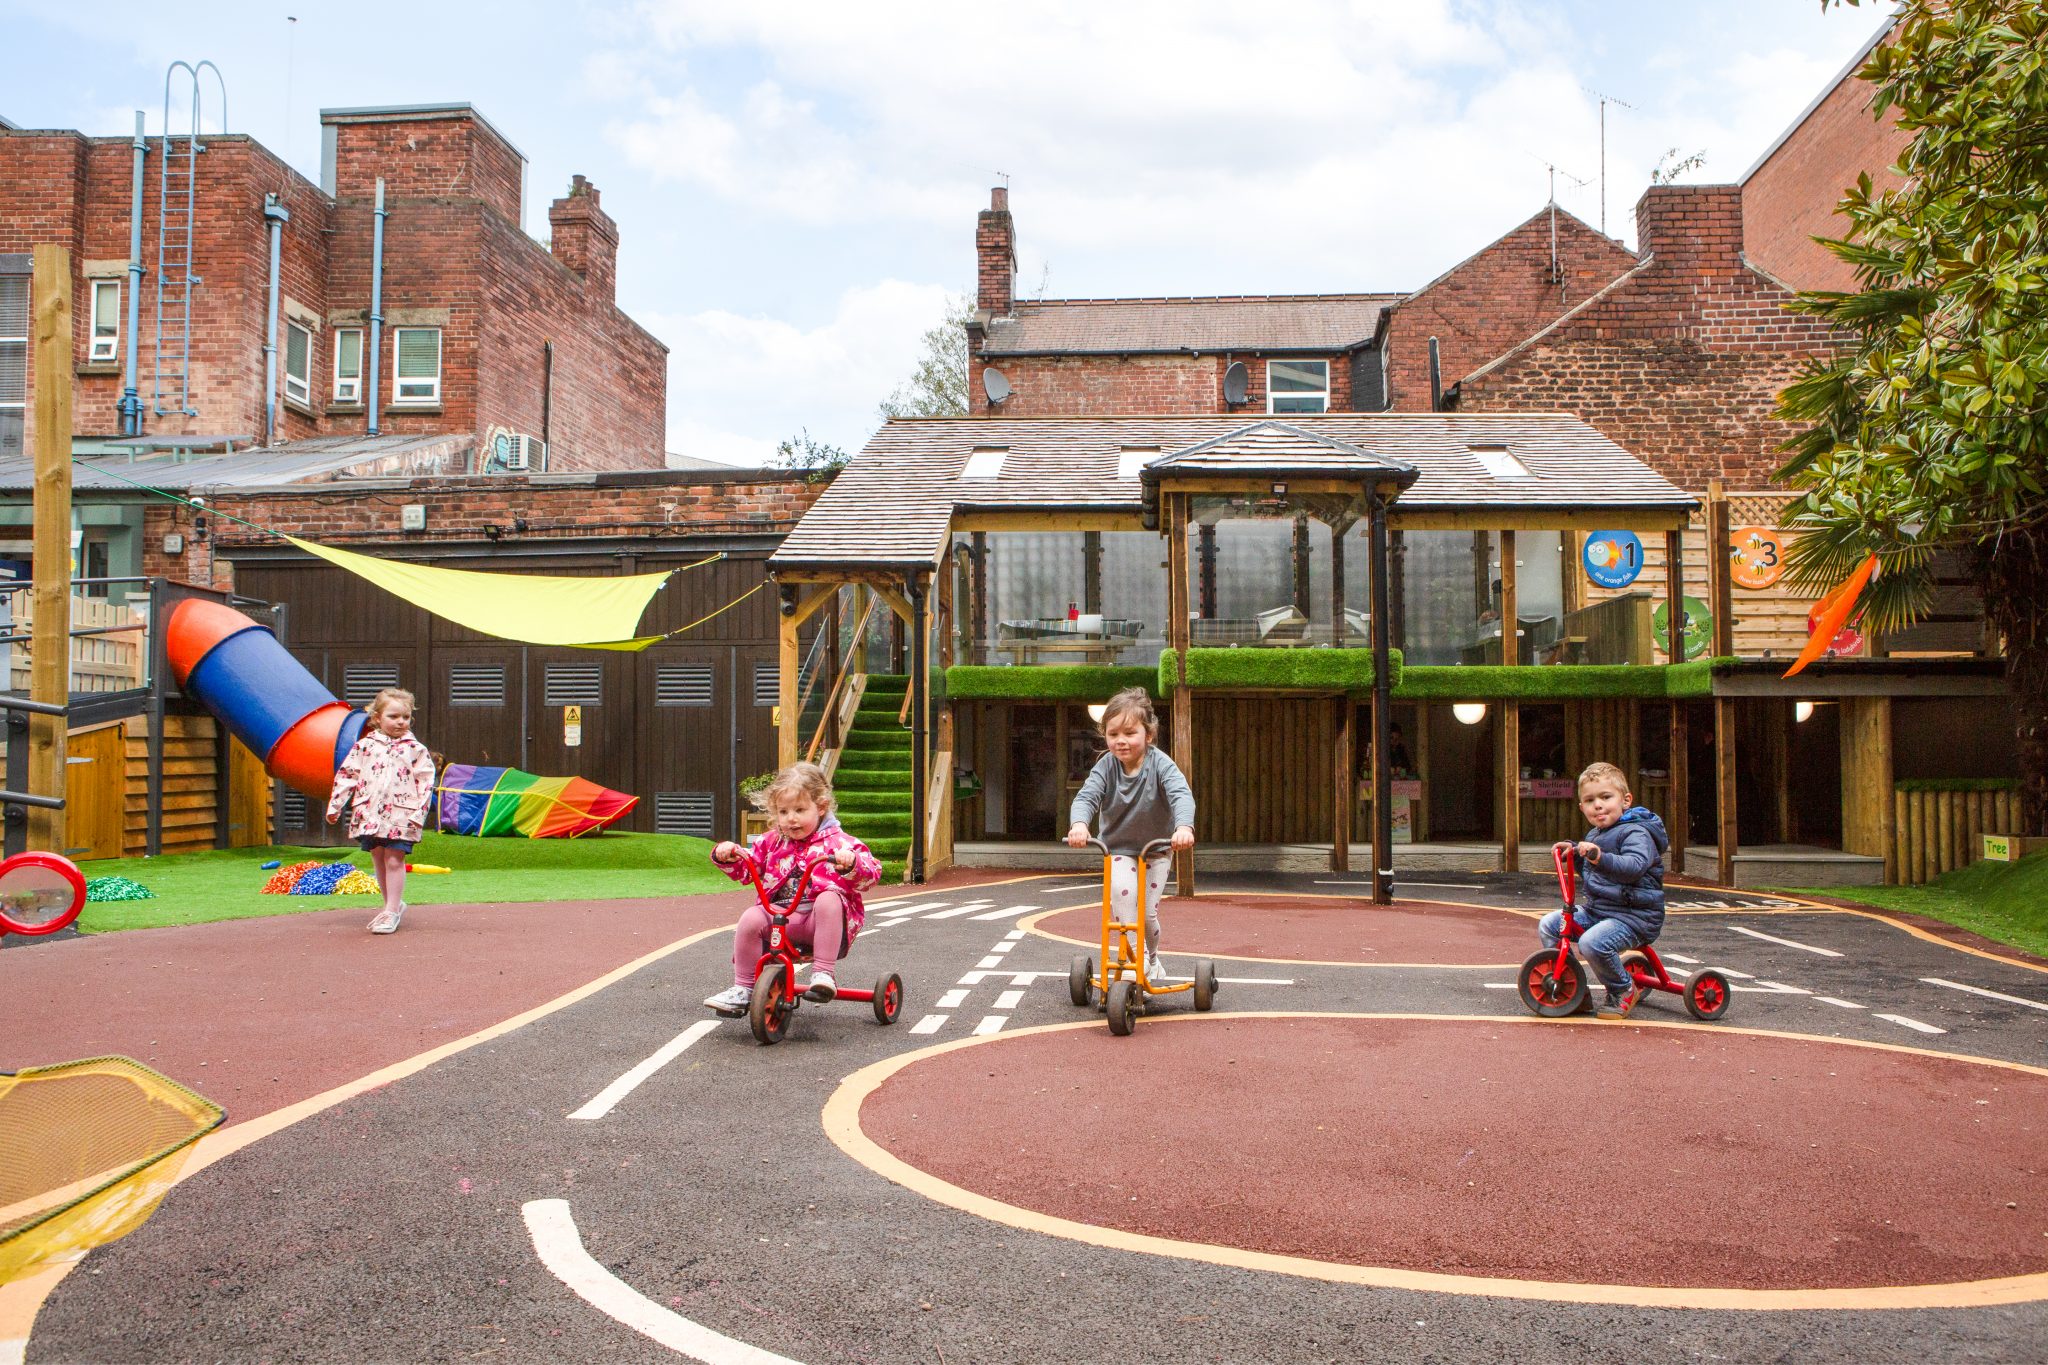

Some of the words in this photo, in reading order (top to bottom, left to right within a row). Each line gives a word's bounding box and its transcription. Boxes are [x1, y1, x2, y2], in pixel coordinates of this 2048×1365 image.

[1625, 542, 1635, 568] 1
[1760, 541, 1778, 567] 3
[1595, 571, 1605, 581] one
[1604, 577, 1623, 585] orange
[1986, 840, 2007, 855] Tree
